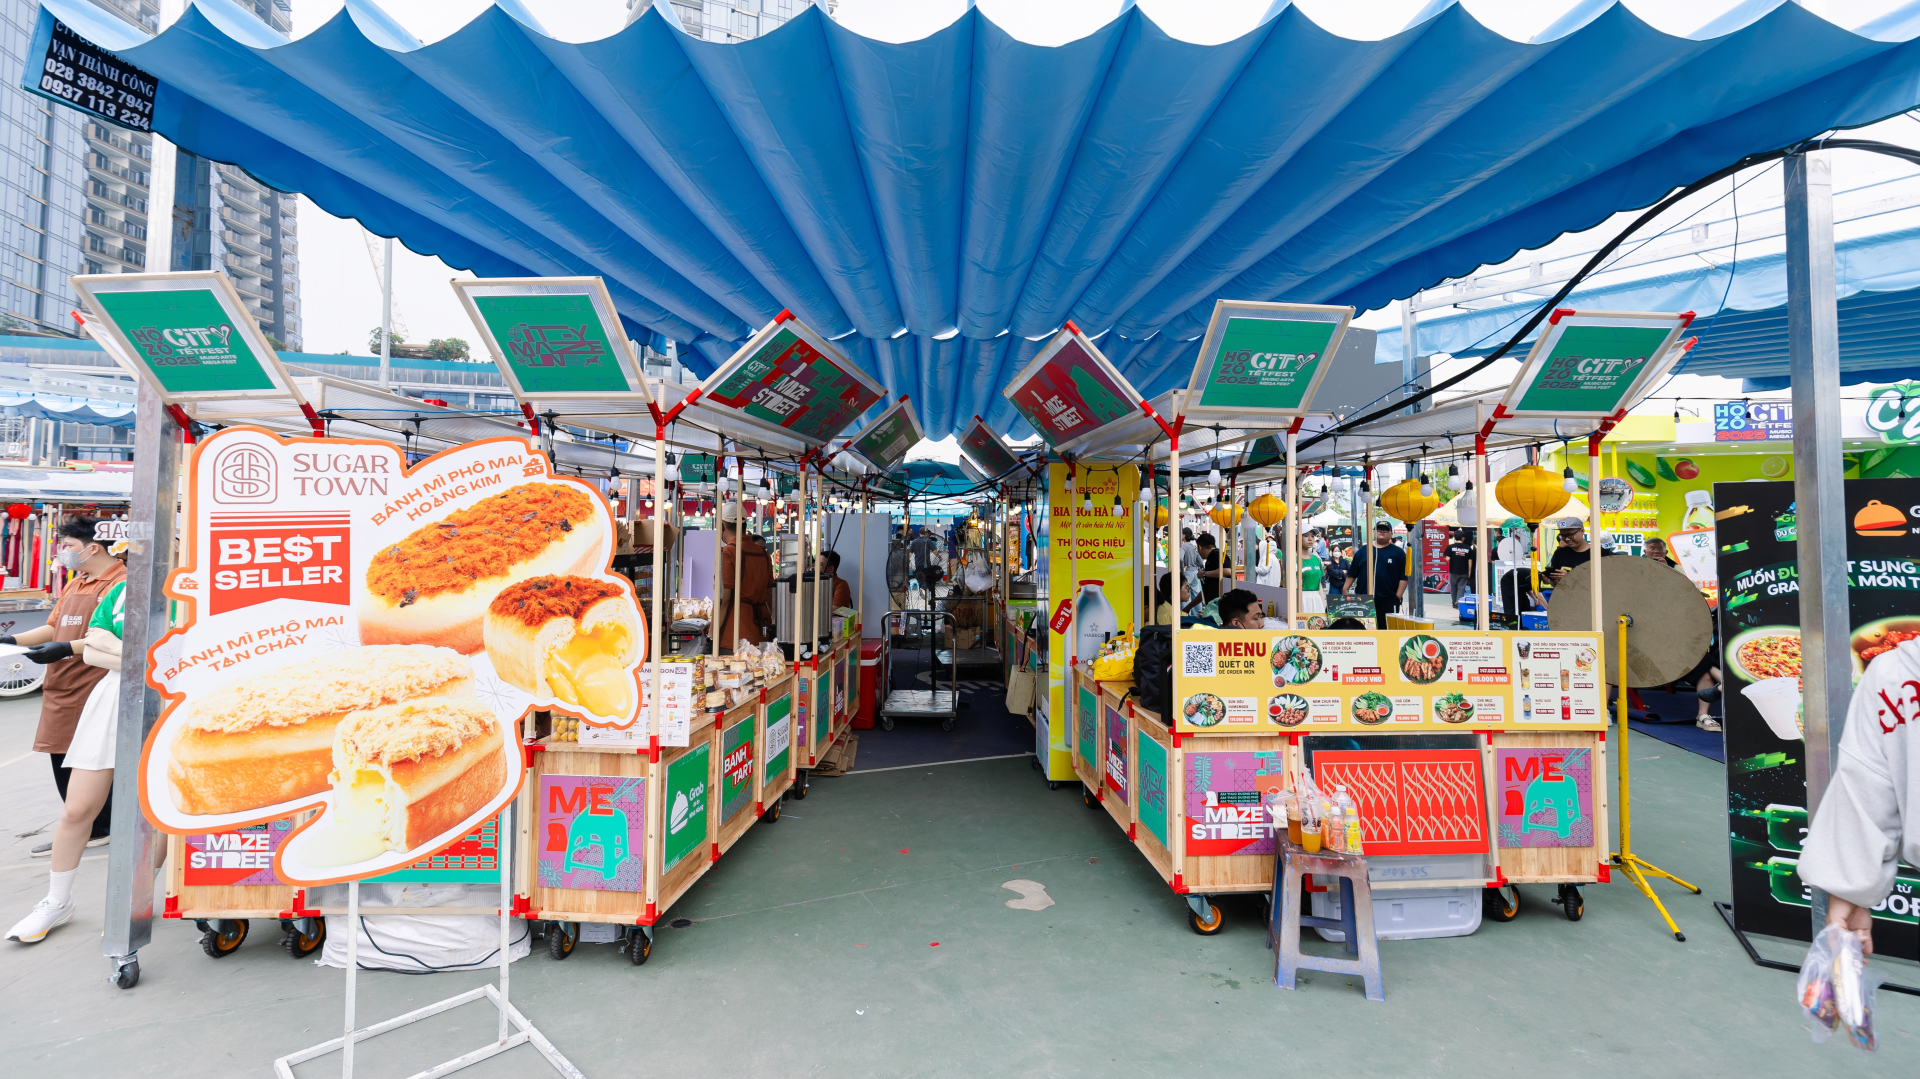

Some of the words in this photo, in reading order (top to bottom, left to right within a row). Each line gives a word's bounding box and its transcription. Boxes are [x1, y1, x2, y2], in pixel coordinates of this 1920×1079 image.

[79, 52, 120, 82] THÀNH
[121, 74, 154, 97] CÔNG
[45, 58, 74, 81] 028
[77, 72, 114, 99] 3842
[117, 90, 153, 114] 7947
[41, 75, 83, 101] 0937
[88, 95, 117, 117] 113
[119, 109, 150, 130] 234
[152, 356, 200, 366] 2025
[1215, 376, 1258, 385] 2025
[1537, 381, 1581, 389] 2025
[751, 387, 801, 416] STREET
[1749, 420, 1793, 429] TẾTFE
[1716, 430, 1767, 440] 2025
[293, 453, 390, 474] SUGAR
[293, 477, 389, 496] TOWN
[371, 488, 422, 526] BÁNH
[422, 474, 447, 494] MÌ
[447, 460, 486, 483] PHÔ
[488, 454, 523, 469] MAI
[406, 485, 469, 522] HOÀNG
[469, 473, 502, 491] KIM
[1053, 506, 1070, 517] BIA
[1094, 504, 1109, 517] HÀ
[1103, 537, 1126, 548] HIỆU
[1612, 534, 1643, 544] VIBE
[1098, 551, 1114, 560] GIA
[214, 565, 343, 590] SELLER
[1736, 568, 1776, 591] MUỐN
[1859, 560, 1916, 574] SUNG
[1766, 582, 1800, 596] GRA
[1858, 572, 1907, 588] MÓN
[163, 644, 224, 681] BÁNH
[226, 631, 254, 650] MÌ
[257, 619, 301, 640] PHÔ
[305, 615, 344, 629] MAI
[254, 634, 308, 656] CHẢY
[1218, 642, 1267, 657] MENU
[1219, 657, 1241, 669] QUÉT
[1244, 660, 1255, 668] QR
[724, 746, 748, 774] BÁNH
[733, 760, 754, 786] TART
[1191, 822, 1274, 840] STREET
[206, 833, 271, 851] MAZE
